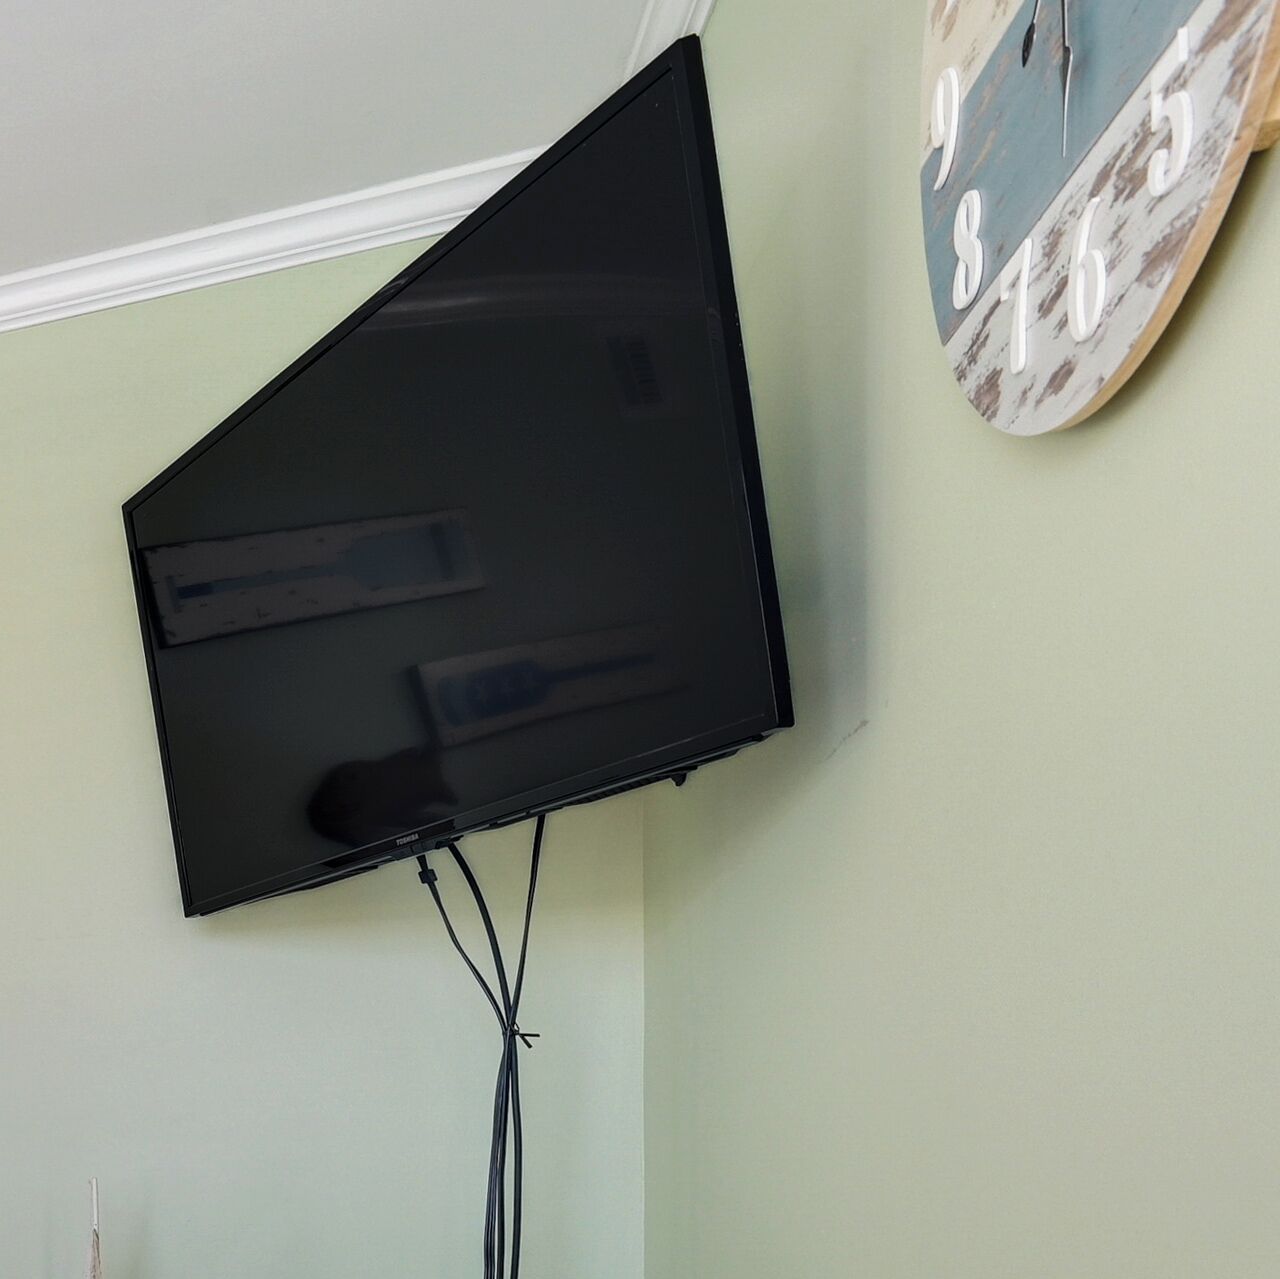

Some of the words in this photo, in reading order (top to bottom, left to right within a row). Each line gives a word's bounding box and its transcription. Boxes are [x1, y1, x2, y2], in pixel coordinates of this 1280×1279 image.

[931, 67, 960, 191] 9
[1147, 26, 1194, 197] 5
[952, 189, 984, 311] 8
[1000, 238, 1032, 375] 7
[1067, 197, 1107, 342] 6
